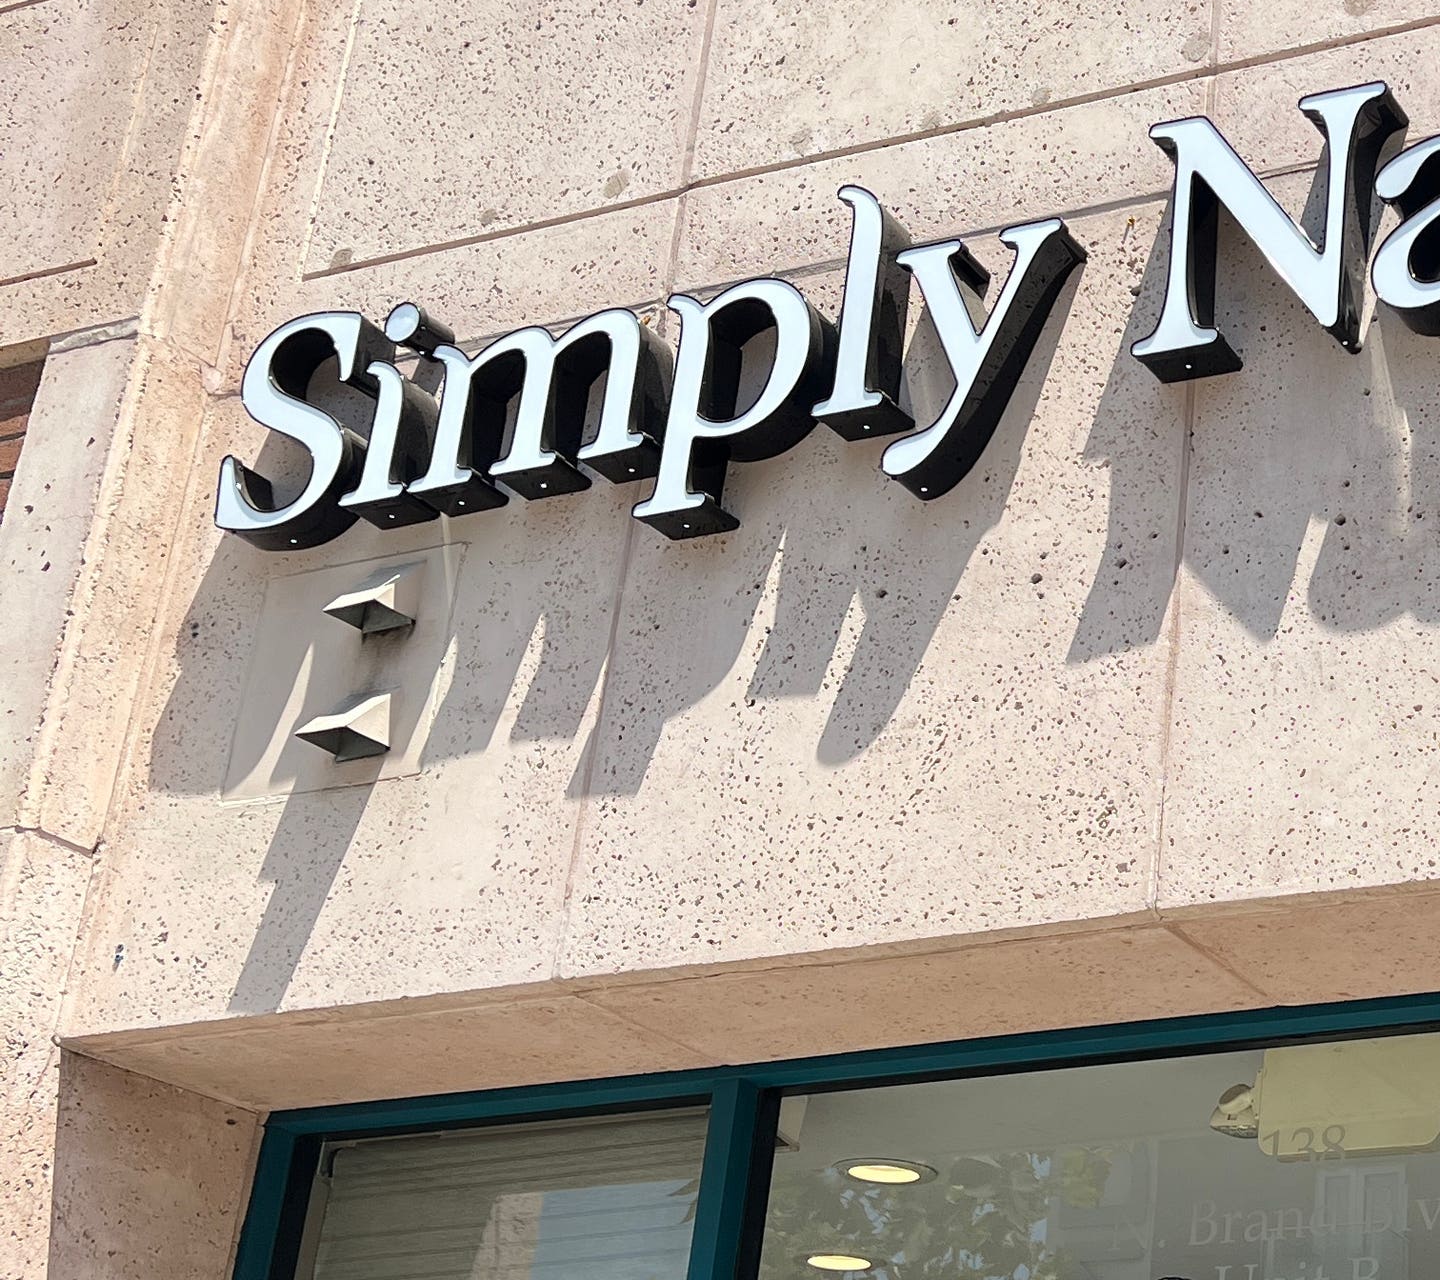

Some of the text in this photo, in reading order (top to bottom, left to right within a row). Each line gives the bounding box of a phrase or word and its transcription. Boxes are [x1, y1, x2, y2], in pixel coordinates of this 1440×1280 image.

[214, 184, 1078, 528] Simply
[1262, 1123, 1347, 1172] 138
[1187, 1188, 1338, 1246] Brand
